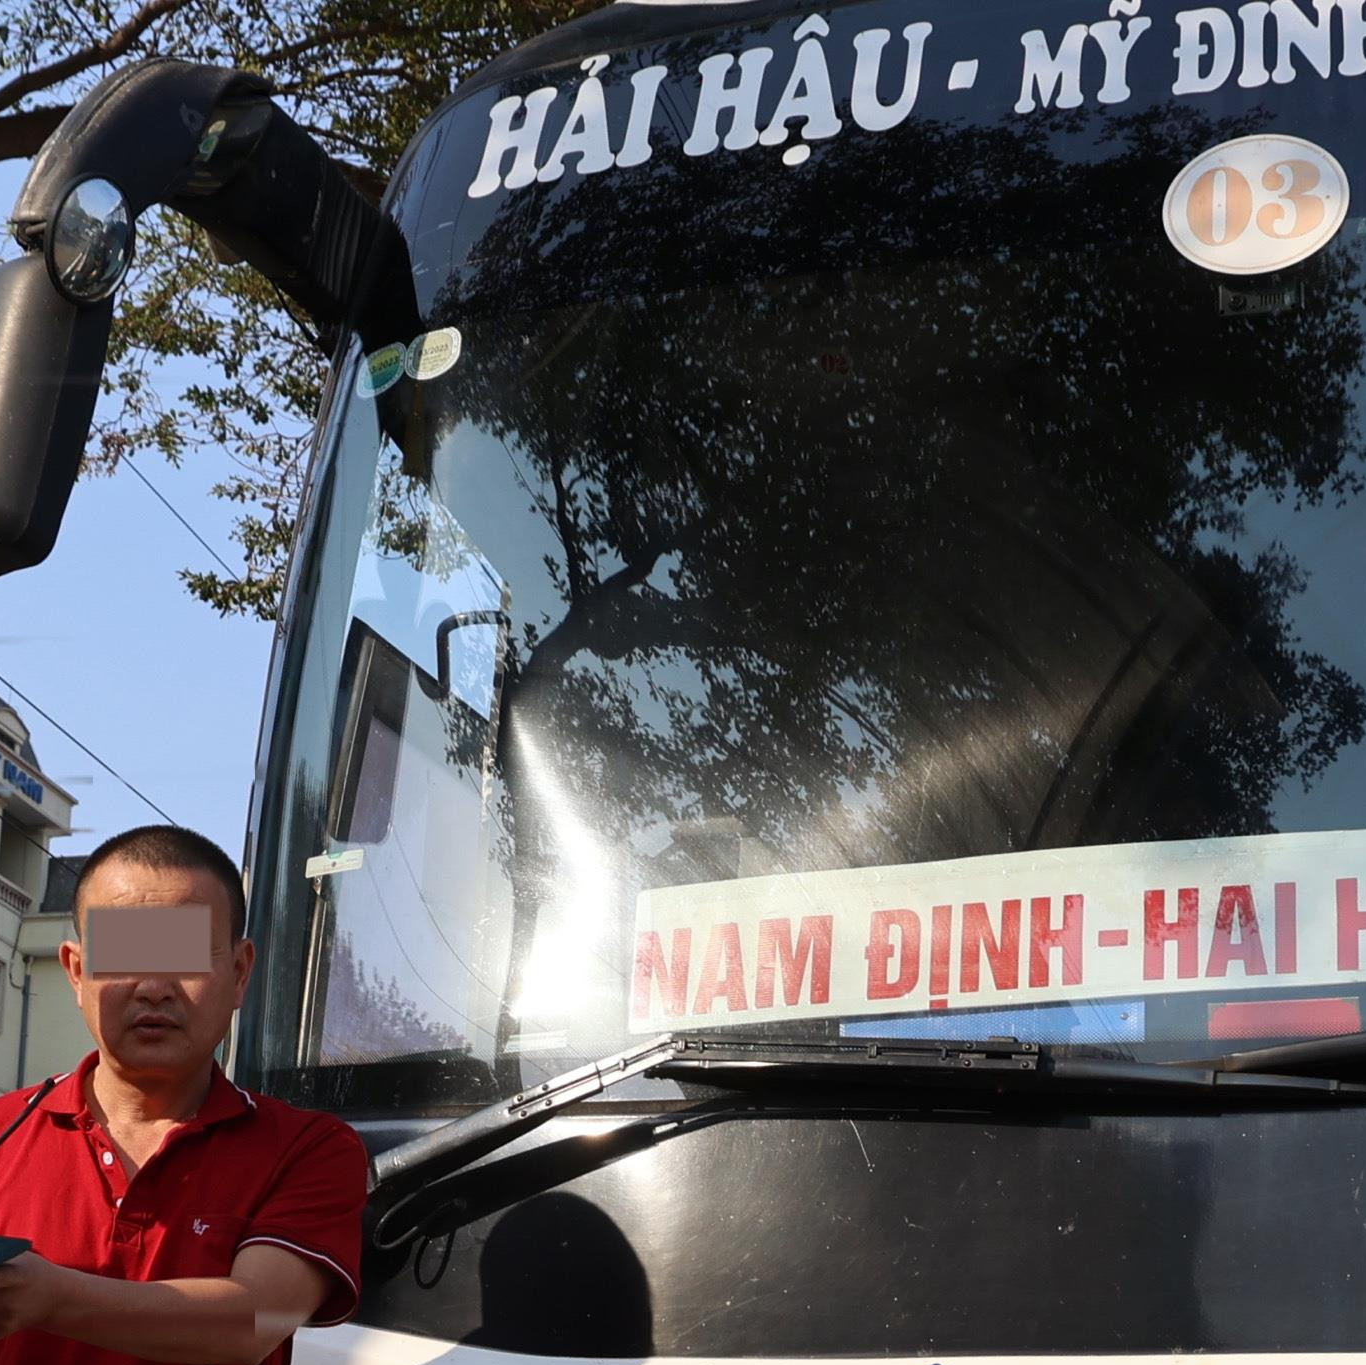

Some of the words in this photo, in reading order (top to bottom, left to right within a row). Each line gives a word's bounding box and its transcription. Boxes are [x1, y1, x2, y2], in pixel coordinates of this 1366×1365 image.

[468, 55, 668, 197] HẢI
[683, 13, 933, 166] HẬU
[1186, 159, 1325, 247] 03
[2, 760, 44, 805] NAM
[635, 914, 833, 1019] NAM
